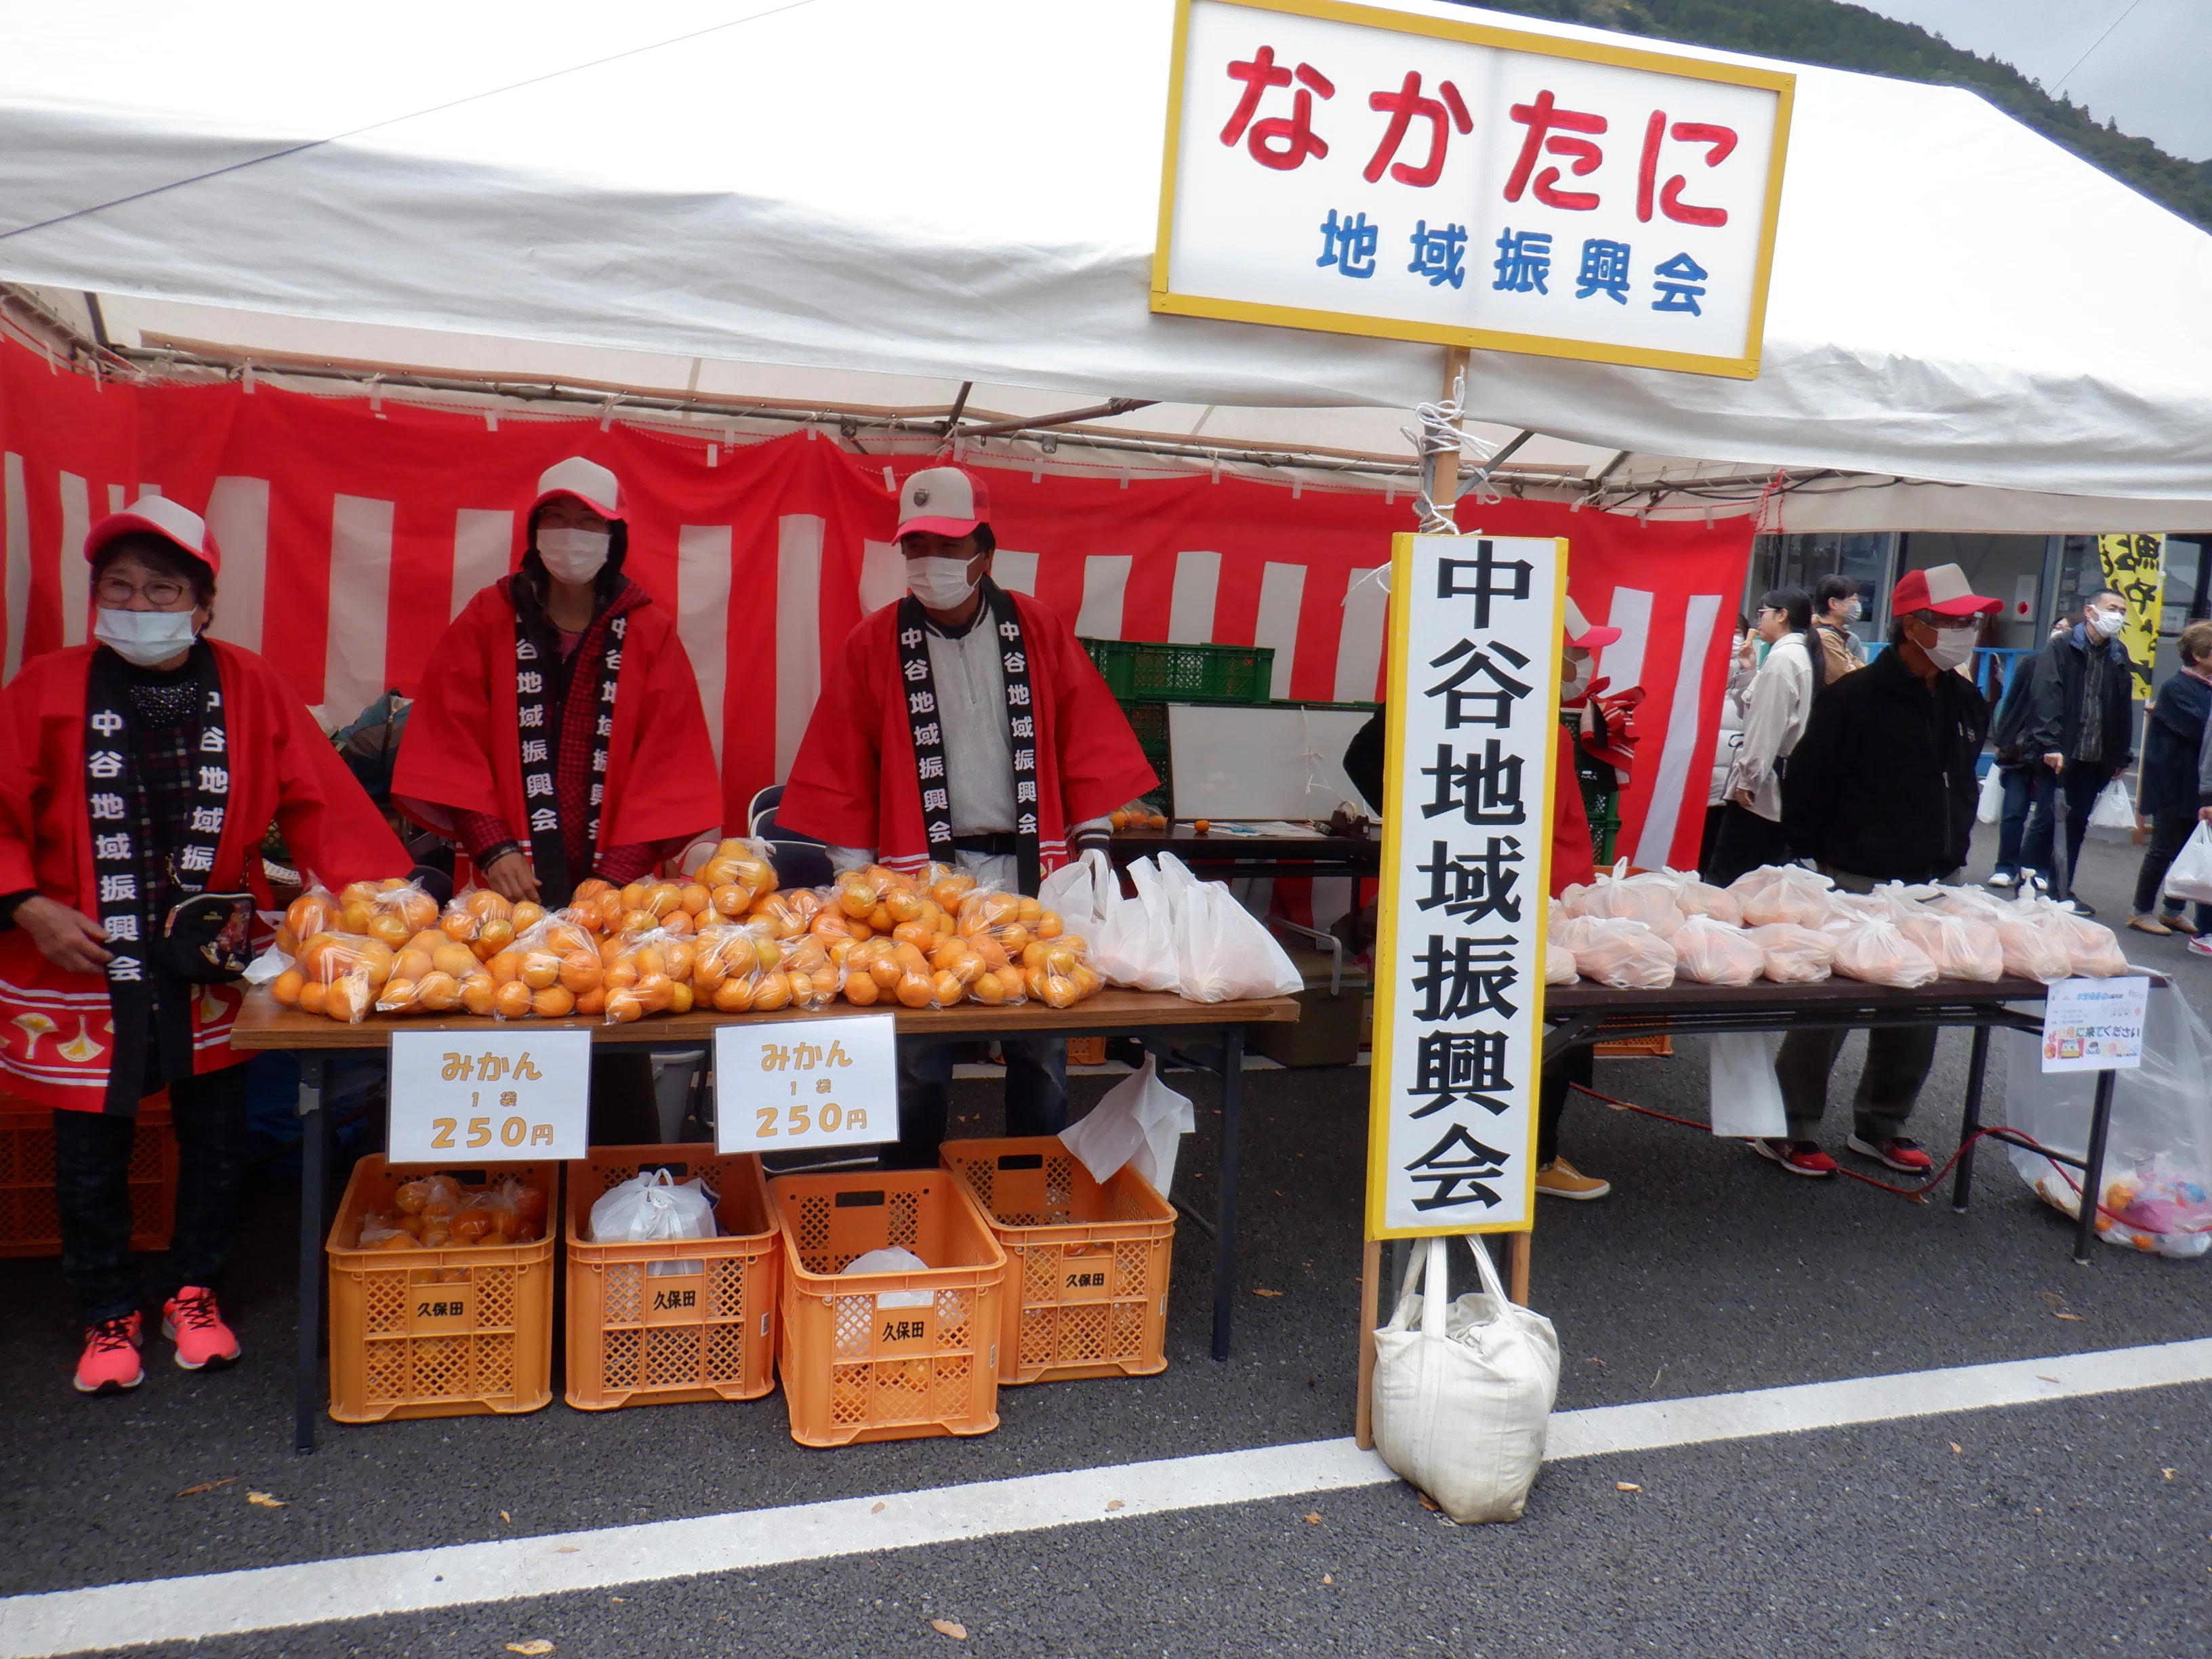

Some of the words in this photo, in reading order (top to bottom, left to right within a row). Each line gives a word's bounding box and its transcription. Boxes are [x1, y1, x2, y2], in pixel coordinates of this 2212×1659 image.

[1219, 45, 1738, 228] なかたに
[1316, 208, 1708, 317] 地域振興会
[516, 613, 558, 832] 谷地域振興会
[901, 627, 951, 844] 中谷地域振興会
[999, 620, 1038, 835] 中谷地域振興会
[180, 691, 228, 892] 谷地域振
[88, 709, 143, 982] 中谷地域振興会
[1403, 539, 1534, 1212] 中谷地域振興会
[441, 1050, 543, 1082] みかん
[760, 1039, 854, 1072] みかん
[430, 1116, 554, 1149] 250円
[756, 1102, 867, 1139] 250円
[417, 1300, 464, 1317] 久保田
[652, 1289, 697, 1311] 久保田
[1065, 1273, 1105, 1288] 久保田
[882, 1321, 925, 1343] 久保田
